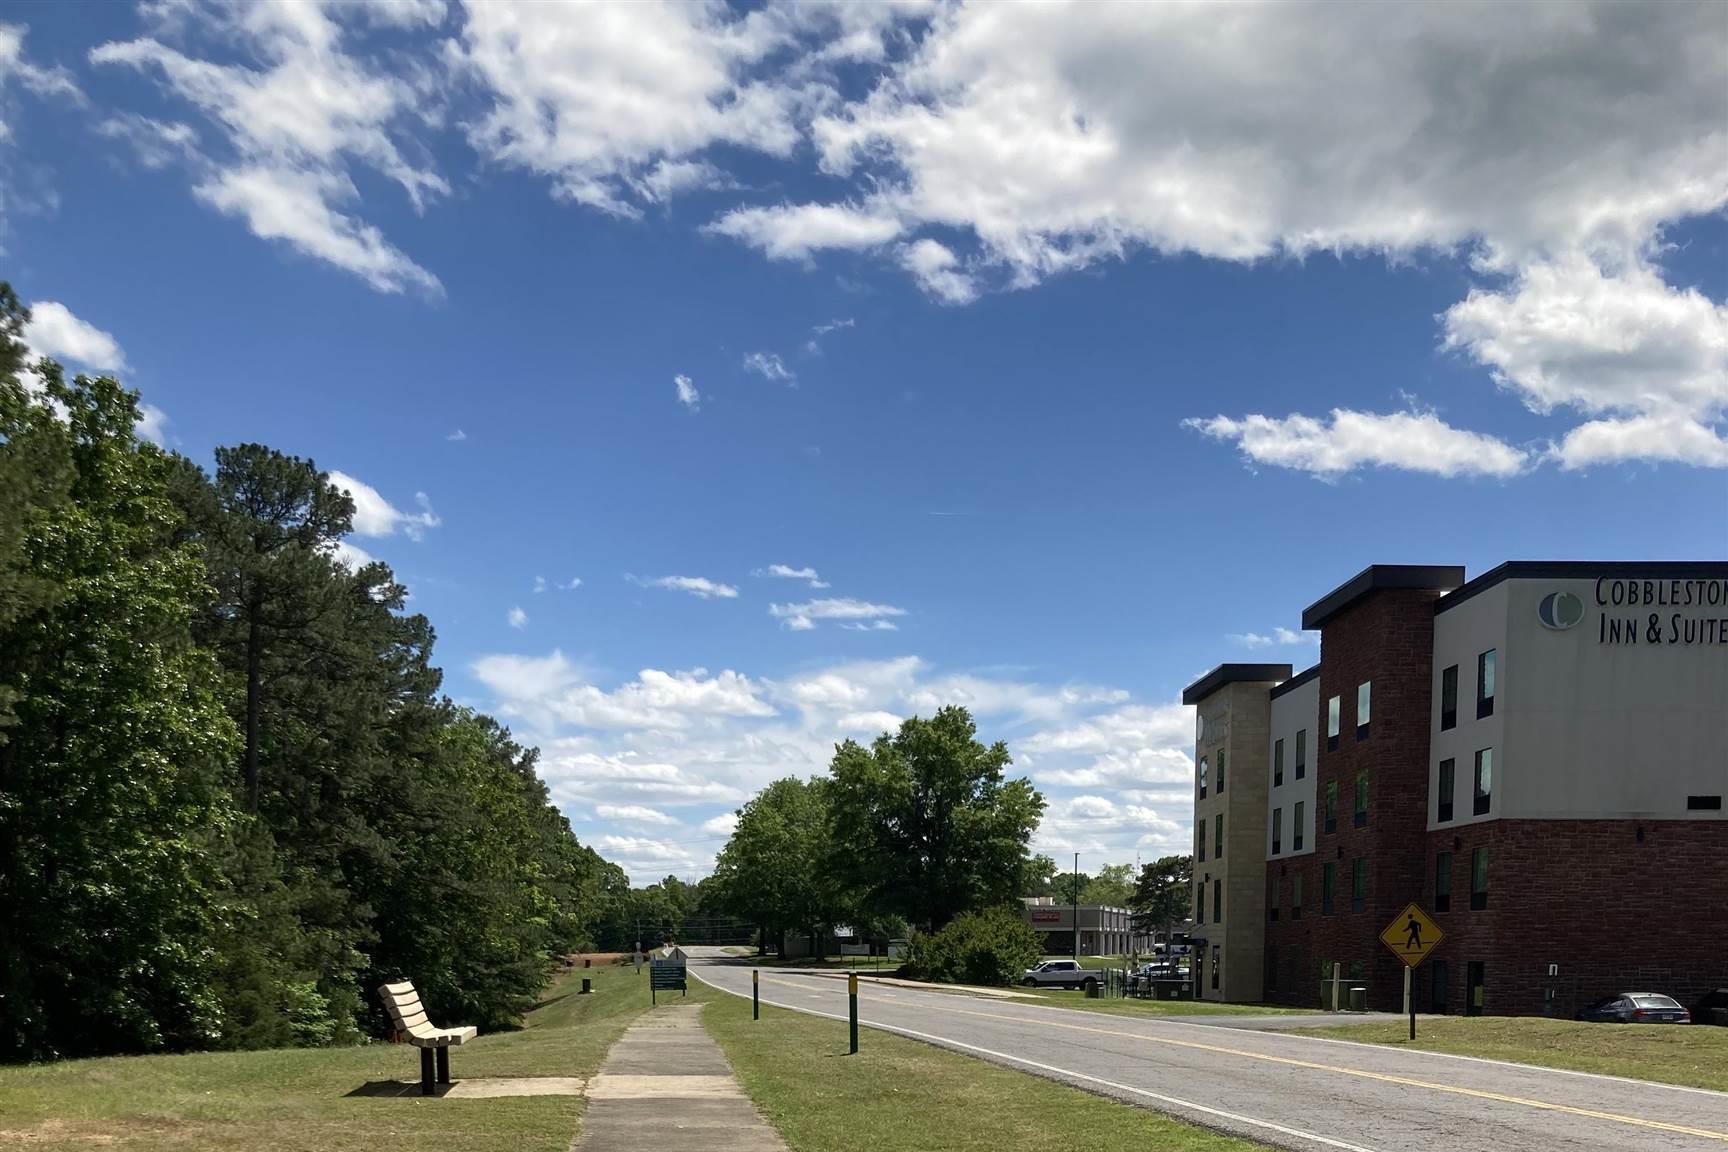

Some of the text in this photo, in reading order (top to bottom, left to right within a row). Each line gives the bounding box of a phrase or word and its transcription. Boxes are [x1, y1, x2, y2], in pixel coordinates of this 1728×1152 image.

[1600, 613, 1728, 644] INN & SUITE
